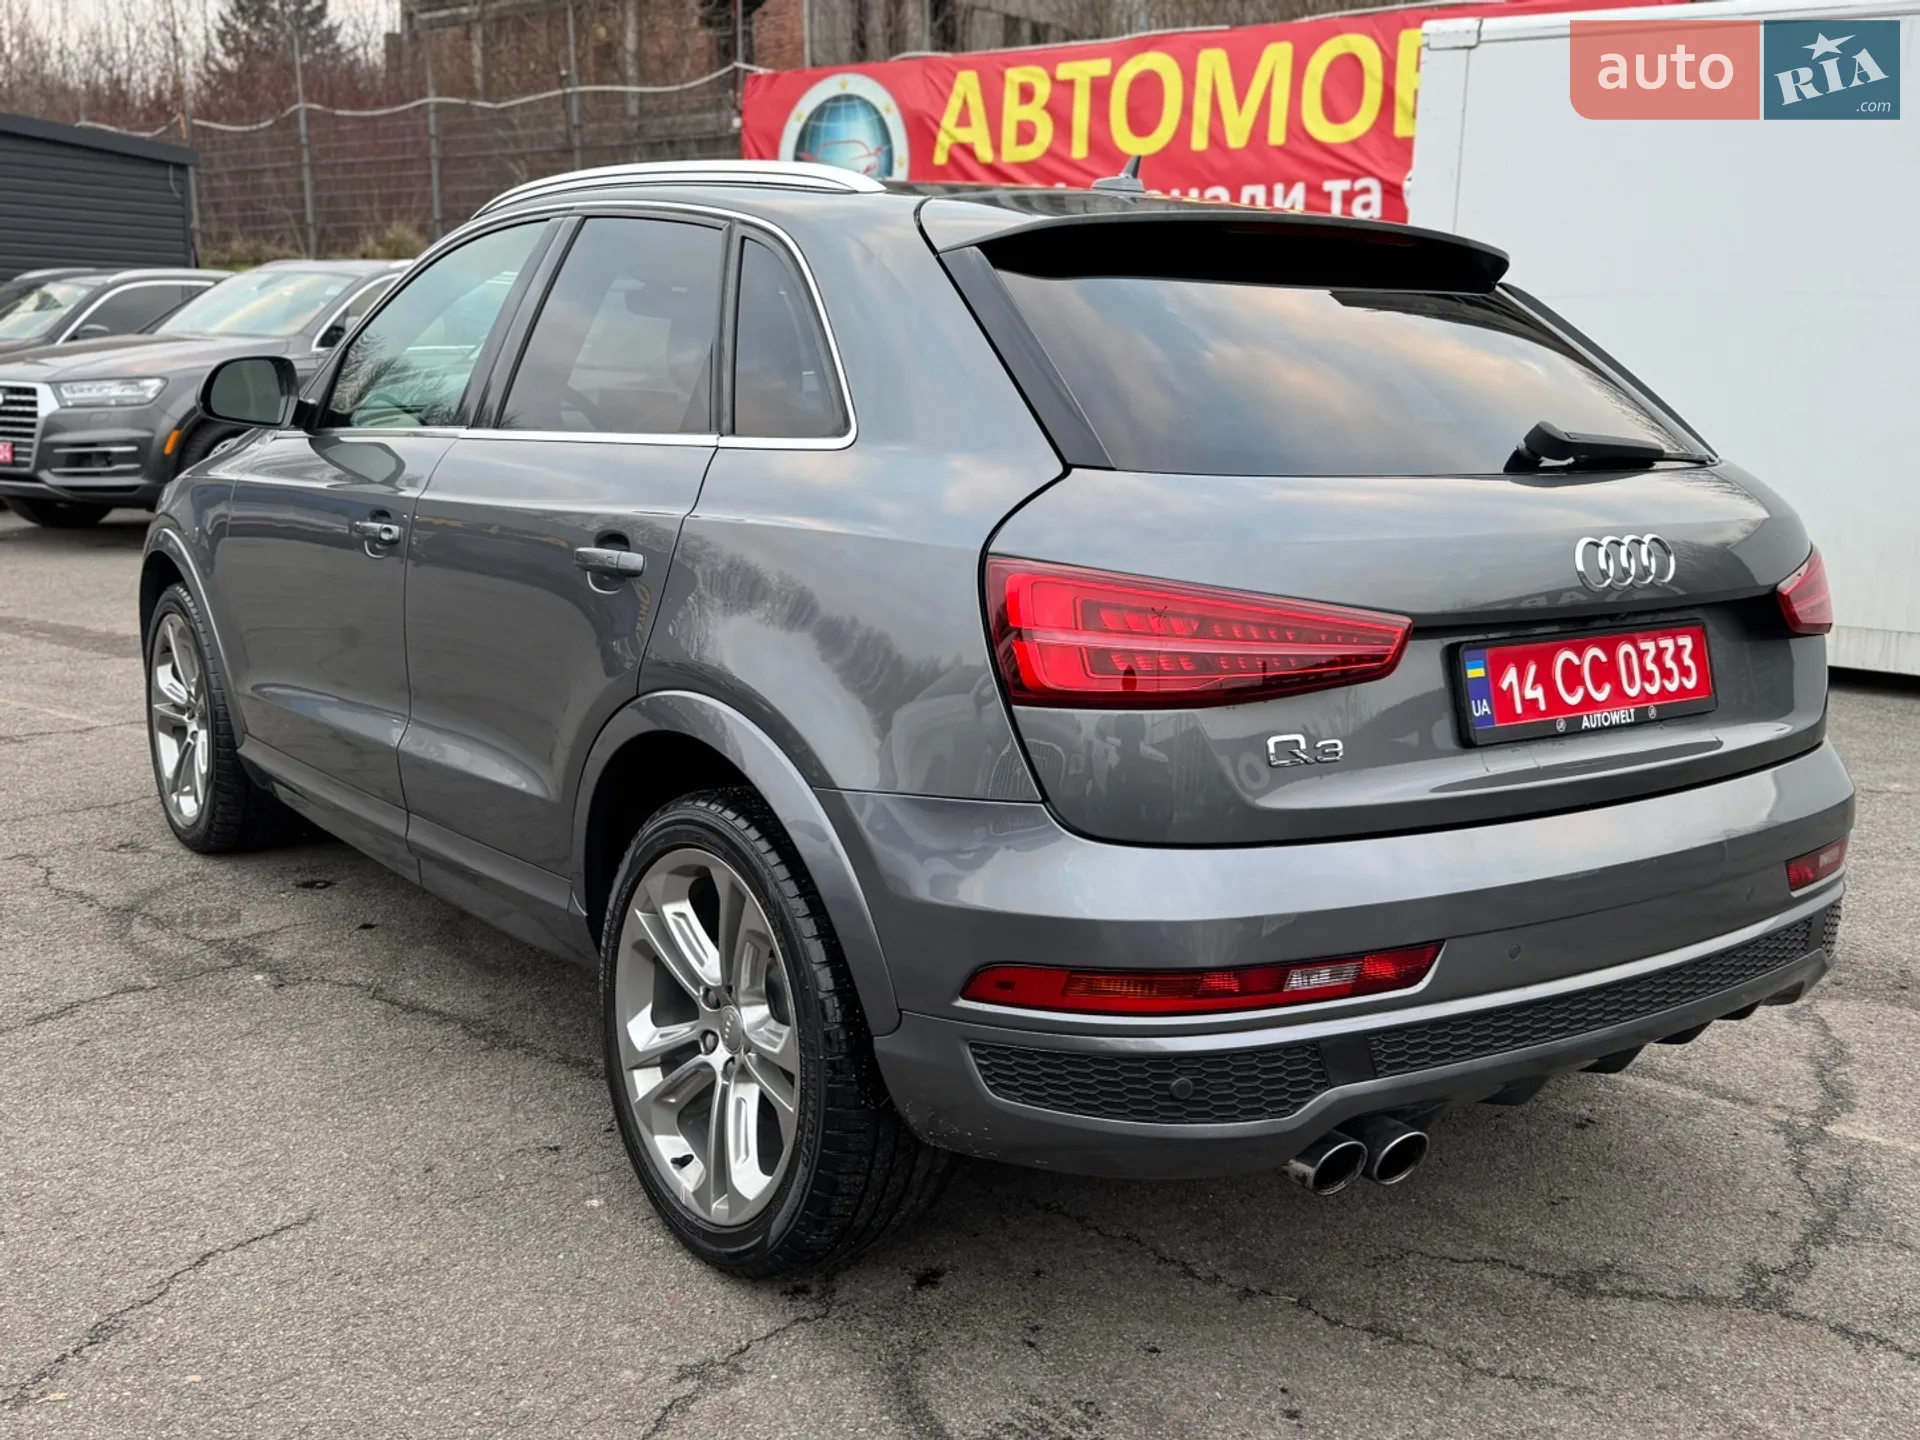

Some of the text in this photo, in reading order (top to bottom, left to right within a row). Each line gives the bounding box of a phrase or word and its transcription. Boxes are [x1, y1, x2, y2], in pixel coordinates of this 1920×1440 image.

[1322, 176, 1383, 219] та
[1499, 634, 1699, 715] 14 CC 0333
[1471, 698, 1491, 717] UA
[1581, 708, 1636, 730] AUTOWELT
[1266, 733, 1344, 767] Q3
